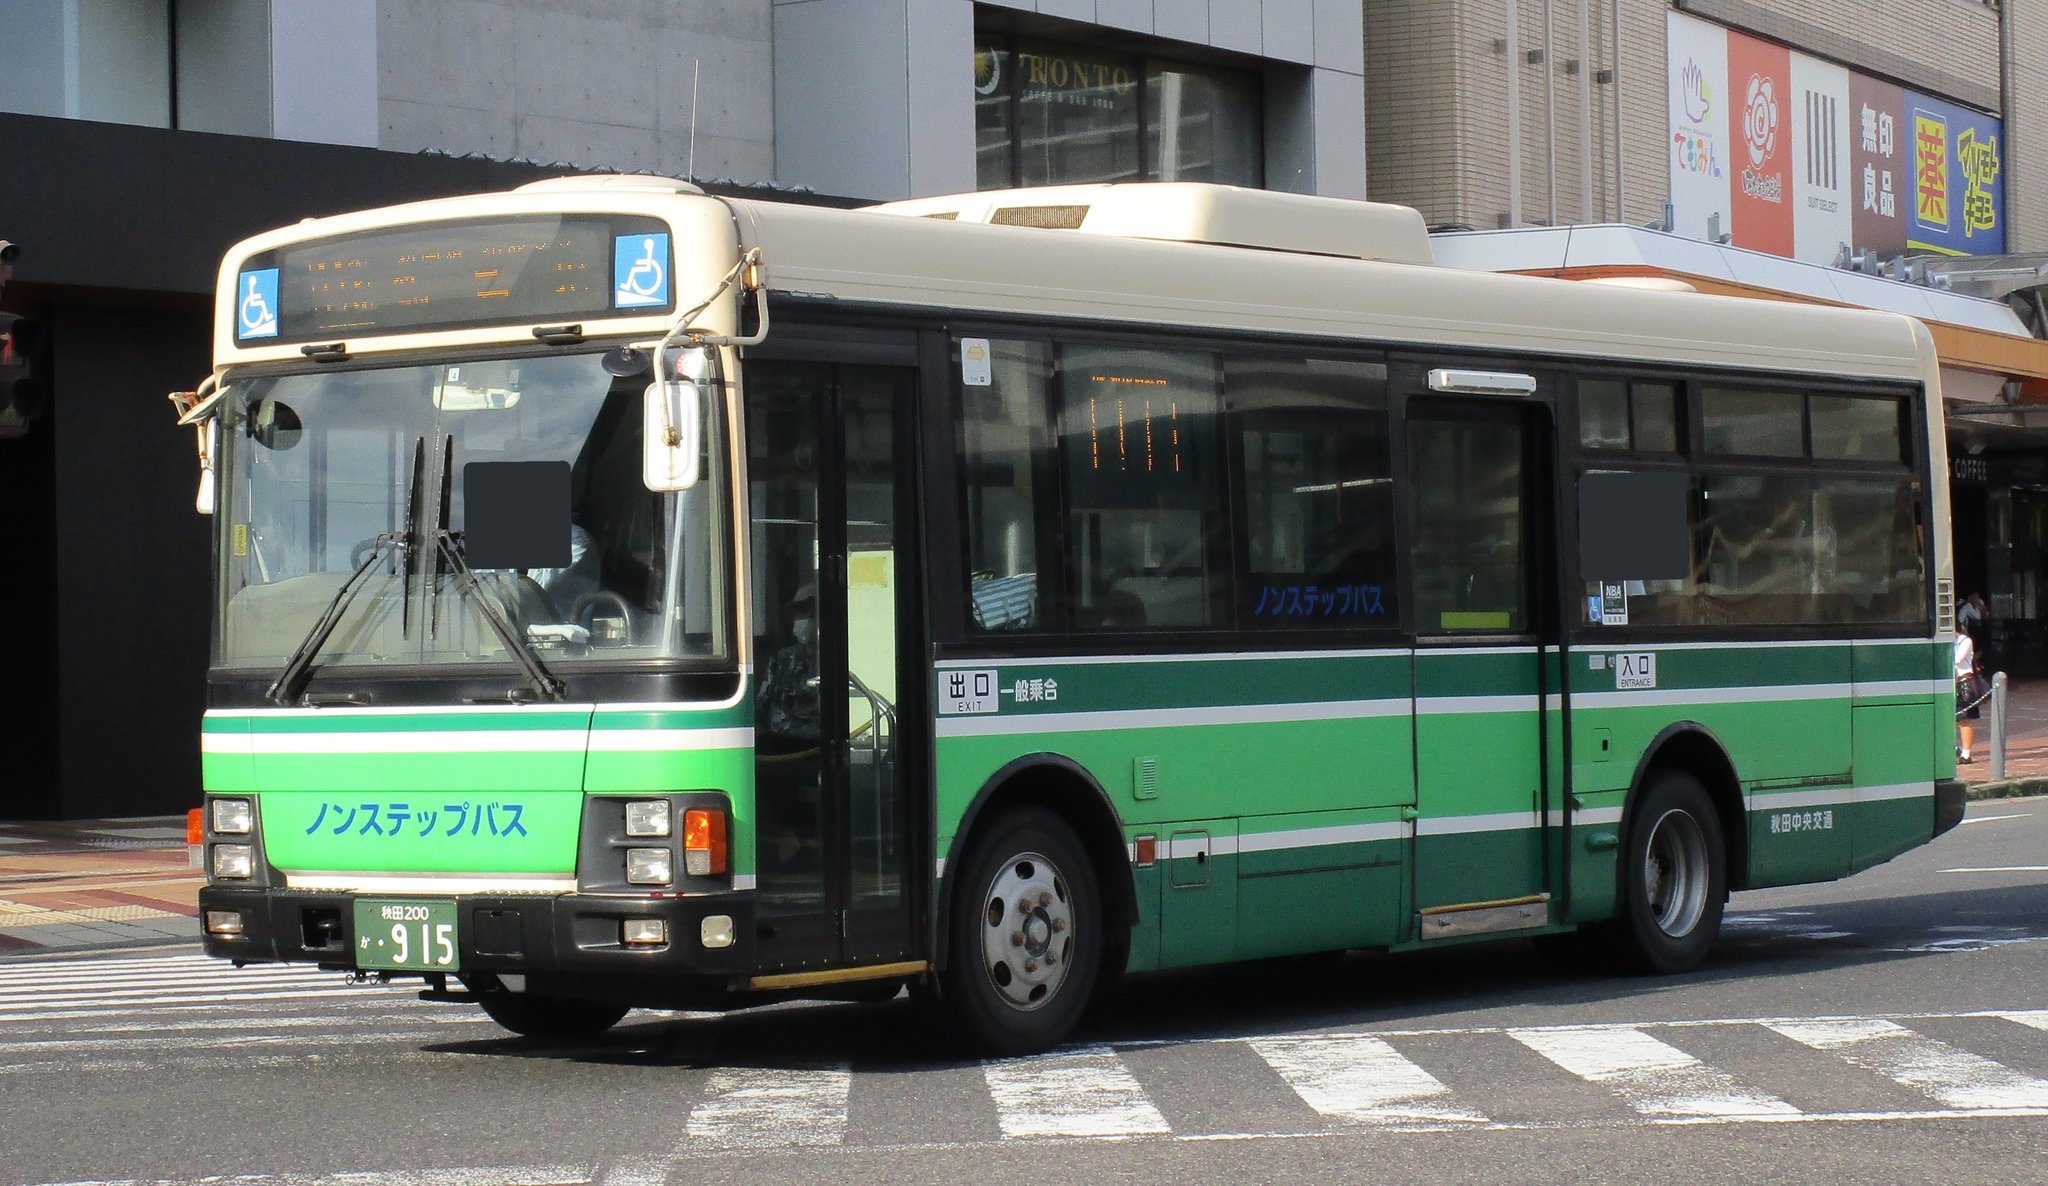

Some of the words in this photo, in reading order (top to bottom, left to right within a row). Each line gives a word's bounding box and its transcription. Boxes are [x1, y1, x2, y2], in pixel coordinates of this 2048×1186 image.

[1019, 55, 1130, 95] RONTO
[1861, 102, 1893, 158] 無印
[1863, 162, 1895, 218] 良品
[1955, 458, 1987, 480] COFFEE
[1254, 584, 1384, 616] ノンステップバス
[1606, 585, 1621, 596] NBA
[1622, 656, 1649, 676] 入口
[950, 672, 989, 698] 出口
[1000, 678, 1058, 702] 一般乗合
[1621, 679, 1651, 687] ENTRANCE
[958, 701, 982, 712] EXIT
[306, 801, 528, 837] ノンステップバス
[1771, 810, 1833, 833] 秋田中央交通
